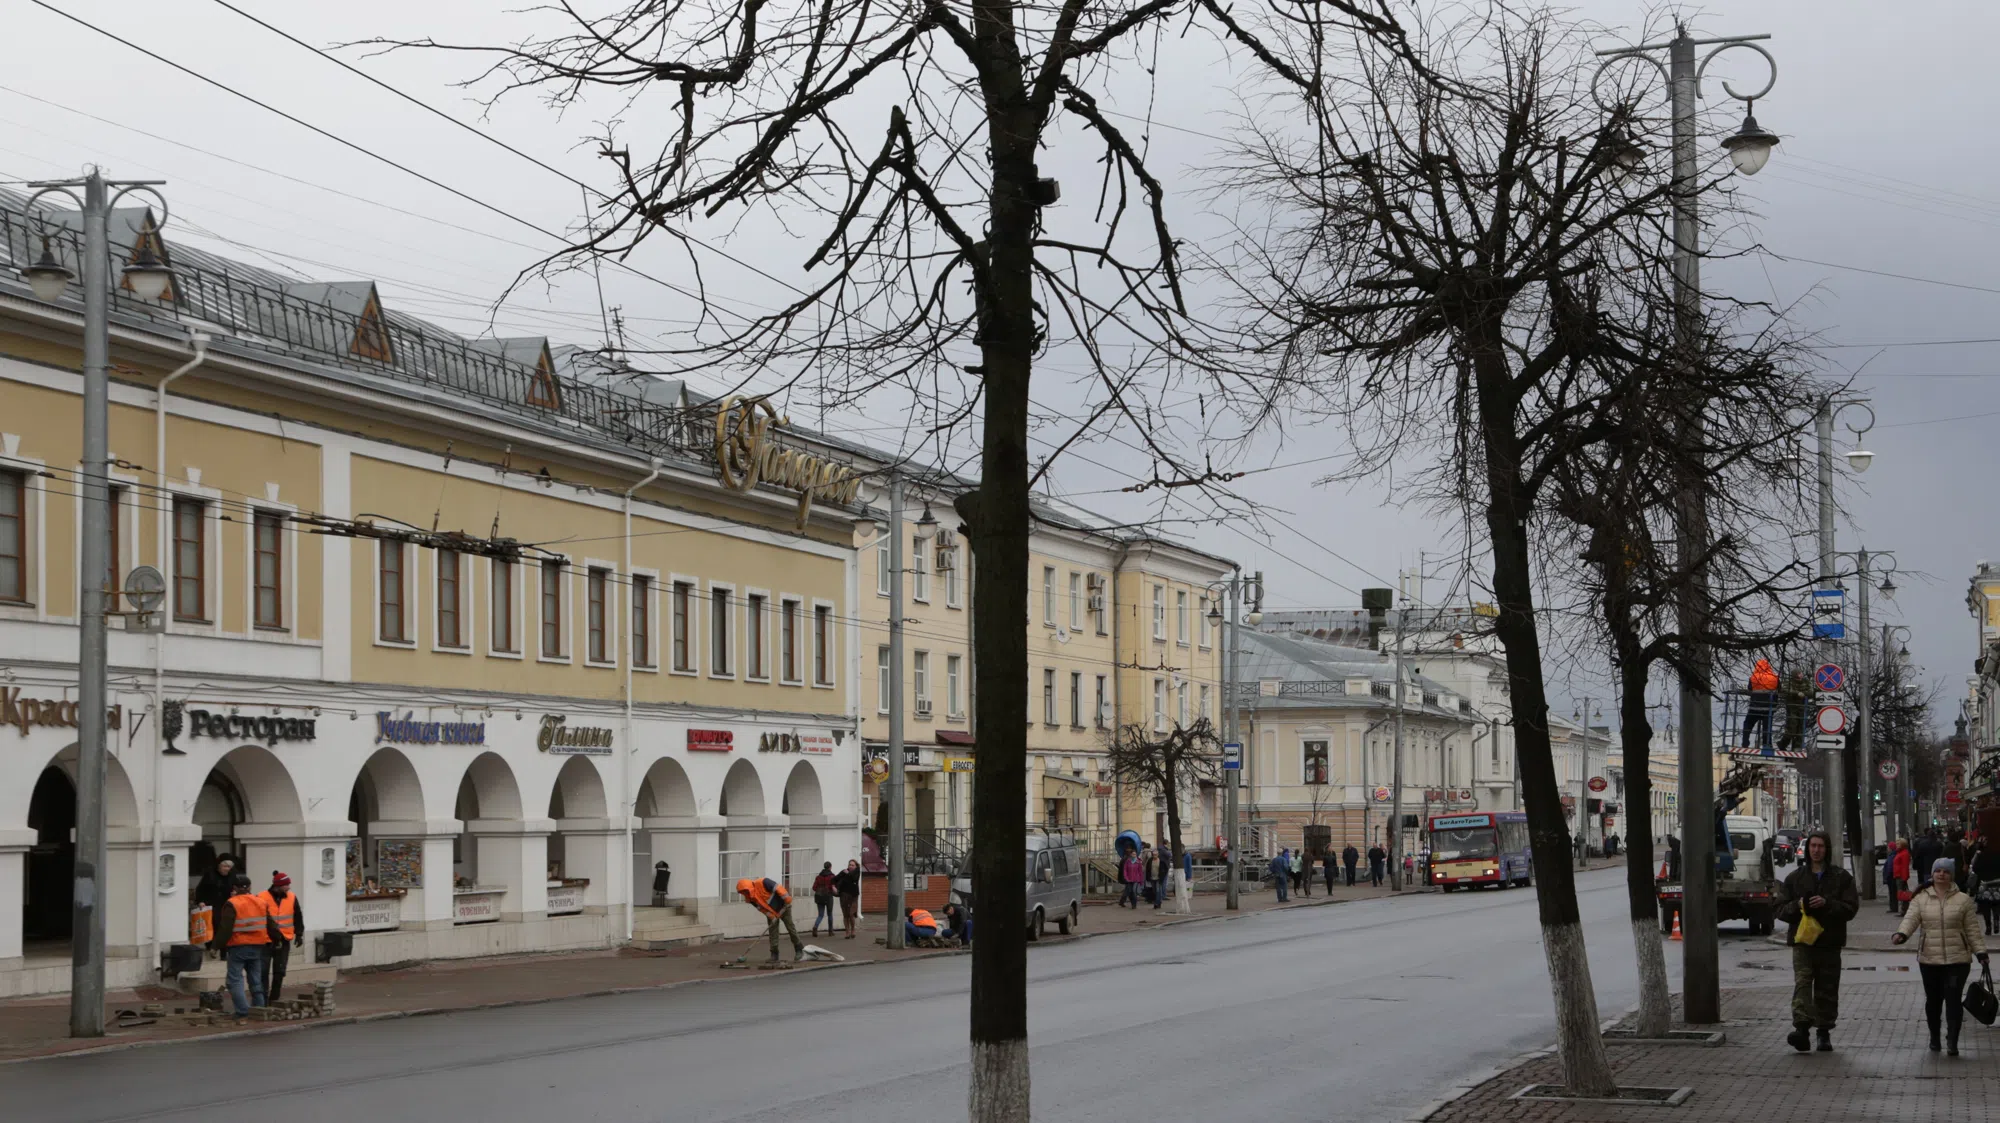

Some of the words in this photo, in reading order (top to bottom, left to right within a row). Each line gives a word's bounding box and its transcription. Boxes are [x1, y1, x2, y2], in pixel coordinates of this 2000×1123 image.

[190, 709, 317, 746] Ресторан
[375, 710, 440, 744] Учебная
[441, 722, 485, 744] книга
[1882, 764, 1896, 774] 50
[459, 904, 491, 917] СУВЕНИРЫ
[351, 912, 390, 926] СУВЕНИРЫ
